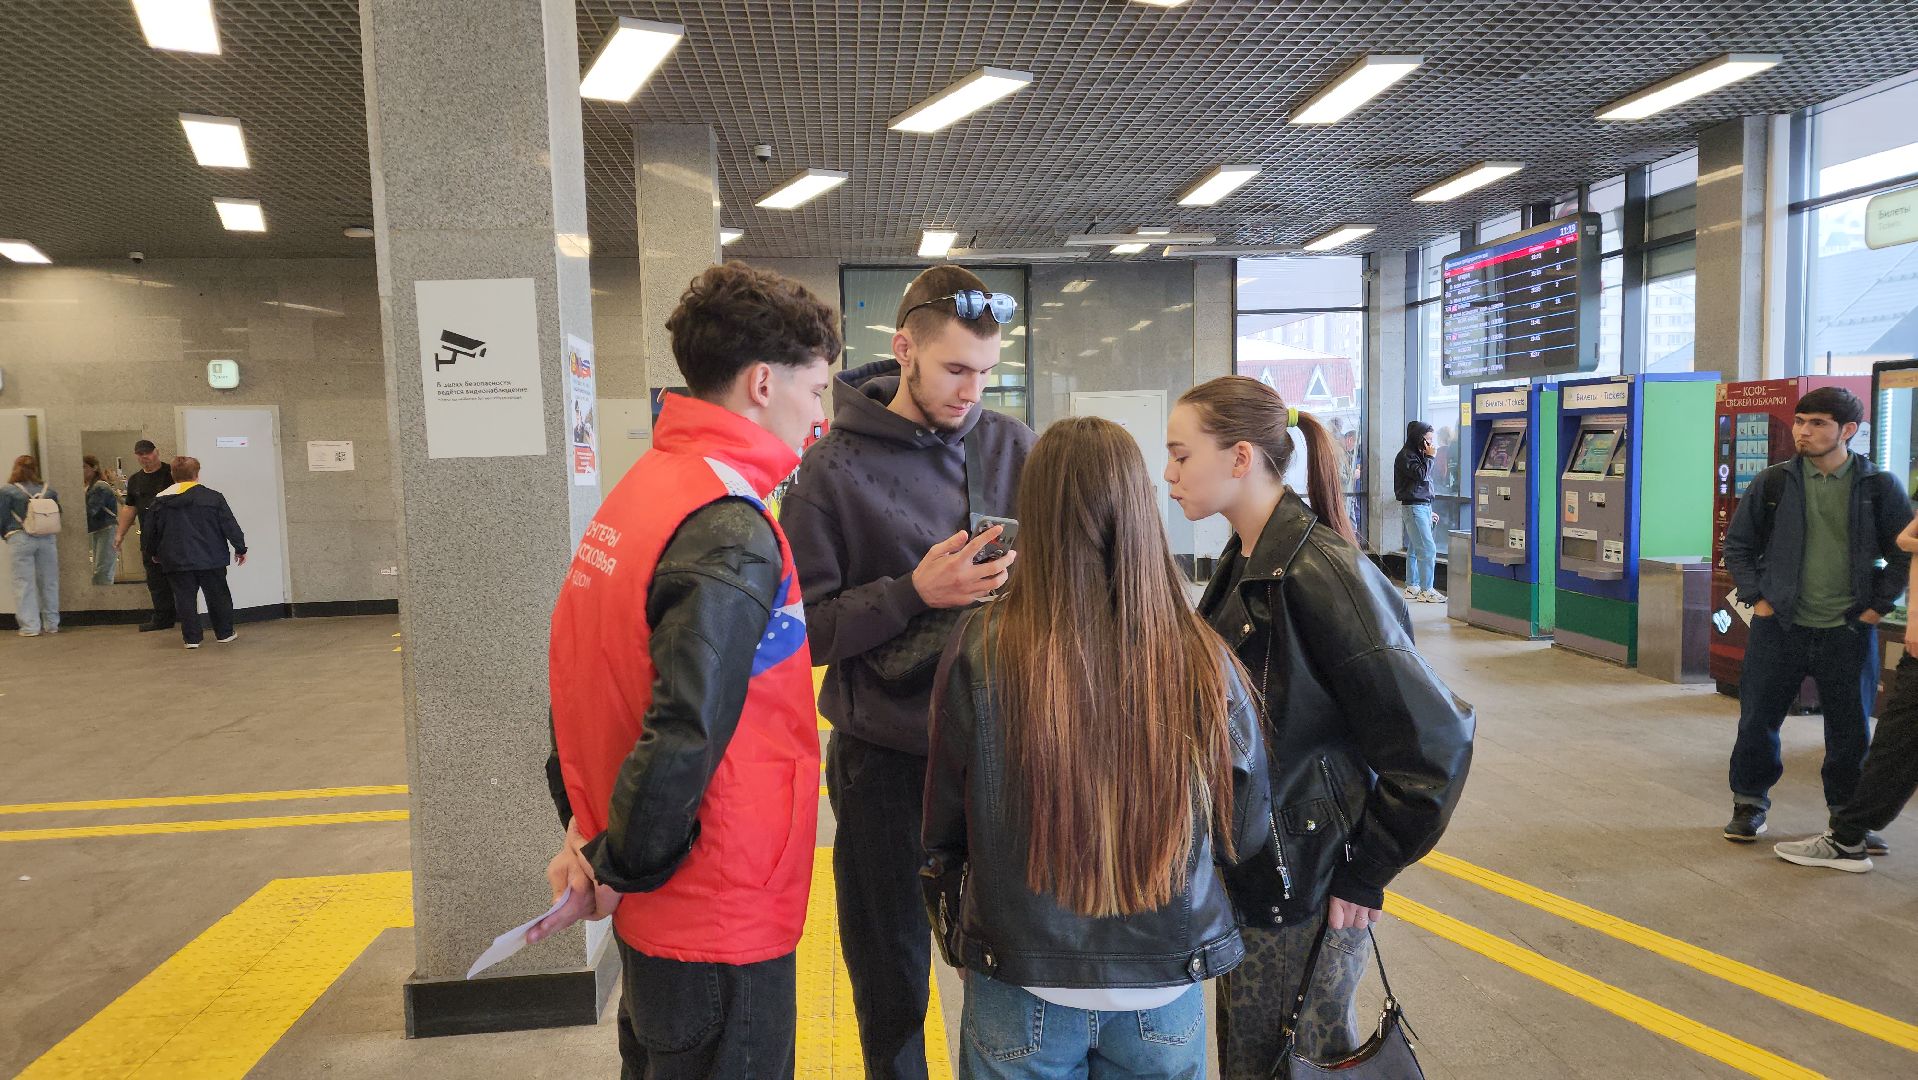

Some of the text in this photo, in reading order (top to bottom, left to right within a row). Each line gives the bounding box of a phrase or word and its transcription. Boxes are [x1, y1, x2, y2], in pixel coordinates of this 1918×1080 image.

[1879, 205, 1911, 219] Билеты
[1560, 224, 1576, 236] 11:19
[1576, 391, 1626, 401] Билеты Tickets
[1743, 385, 1767, 396] КОФЕ
[1725, 396, 1787, 407] СВЕЖЕЙ ОБЖАРКИ
